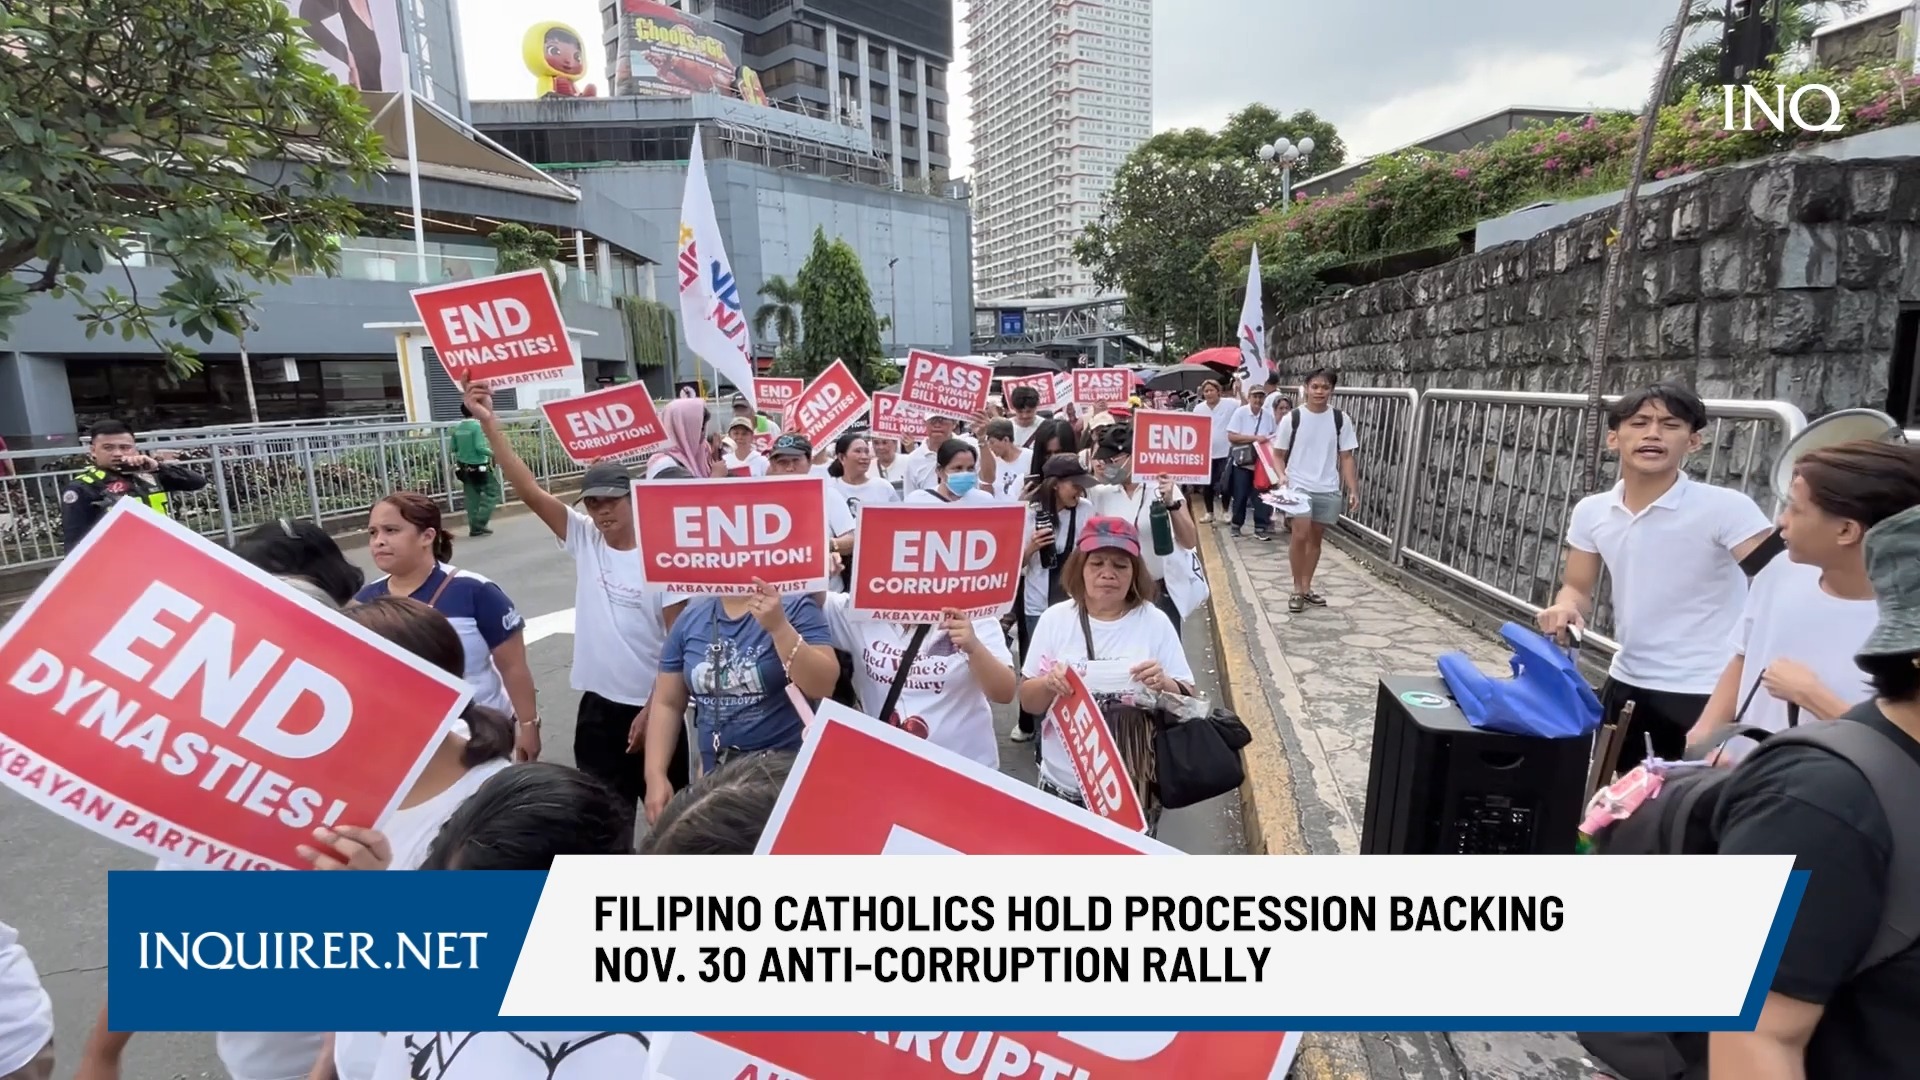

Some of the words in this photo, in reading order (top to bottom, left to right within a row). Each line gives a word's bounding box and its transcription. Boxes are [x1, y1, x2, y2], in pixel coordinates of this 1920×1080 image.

[440, 297, 531, 345] END
[444, 334, 558, 368] DYNASTIES!
[509, 369, 564, 385] PARTYLIST
[914, 357, 983, 392] PASS
[1078, 373, 1124, 388] PASS
[760, 384, 793, 398] END
[910, 388, 936, 403] BILL
[938, 394, 977, 411] NOW!
[912, 380, 979, 399] ANTI-DYNASTY
[1099, 392, 1123, 400] NOW!
[799, 382, 842, 428] END
[879, 397, 926, 418] PAS
[565, 403, 635, 438] END
[879, 415, 926, 424] ANTI-DYNAS
[879, 420, 898, 431] BILL
[900, 423, 927, 433] NOW
[569, 423, 655, 451] CORRUPTION!
[1149, 424, 1198, 450] END
[1140, 452, 1204, 466] DYNASTIES!
[673, 503, 792, 548] END
[655, 547, 813, 570] CORRUPTION!
[891, 530, 998, 573] END
[666, 584, 734, 594] AKBAYAN
[738, 581, 808, 594] PARYLIST
[868, 573, 1008, 595] CORRUPTION!
[872, 611, 940, 622] AKBAYAN
[943, 605, 999, 622] PTYLIST
[89, 579, 354, 759] END
[933, 661, 948, 676] &
[9, 647, 347, 830] DYNASTIES!
[1073, 699, 1122, 811] END
[0, 743, 115, 822] KBAYAN
[114, 809, 285, 871] PARTYLIS
